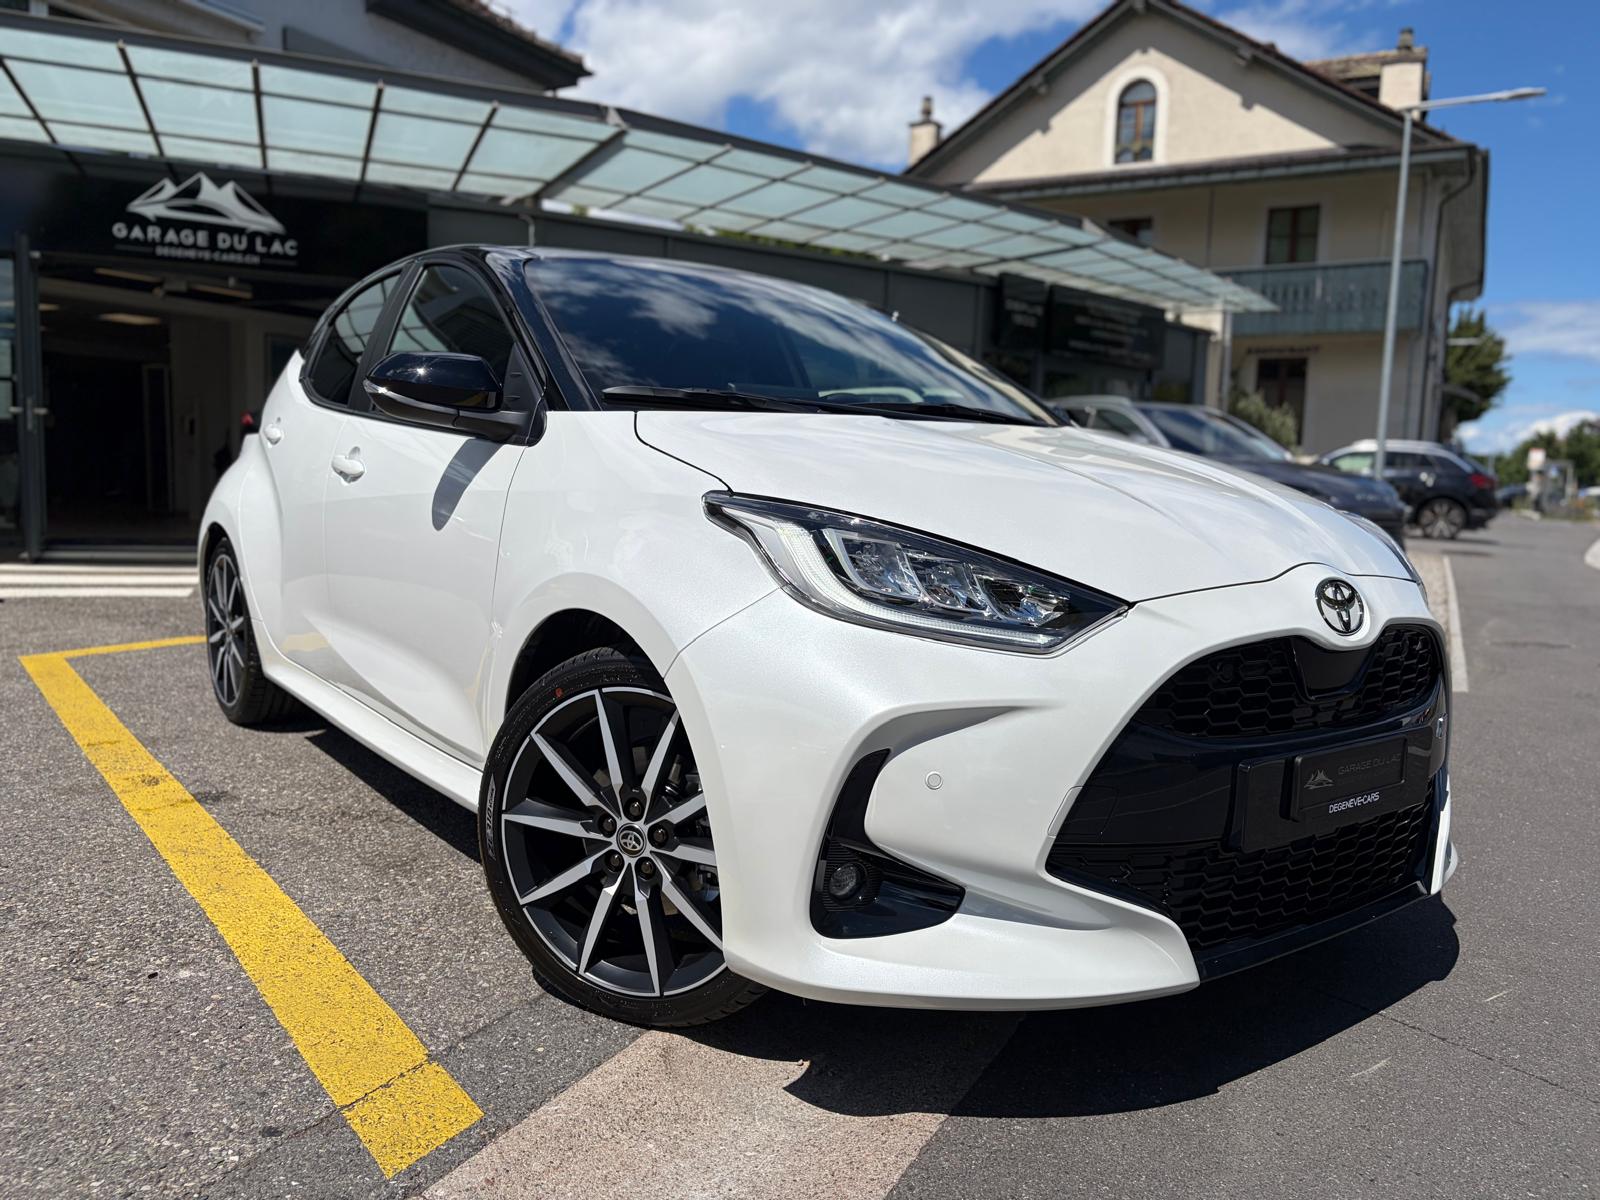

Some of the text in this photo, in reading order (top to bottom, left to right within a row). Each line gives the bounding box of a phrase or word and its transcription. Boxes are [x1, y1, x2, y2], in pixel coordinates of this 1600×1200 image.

[111, 222, 299, 256] GARAGE DU LAC
[1328, 791, 1380, 814] DEGENEVE-CARS
